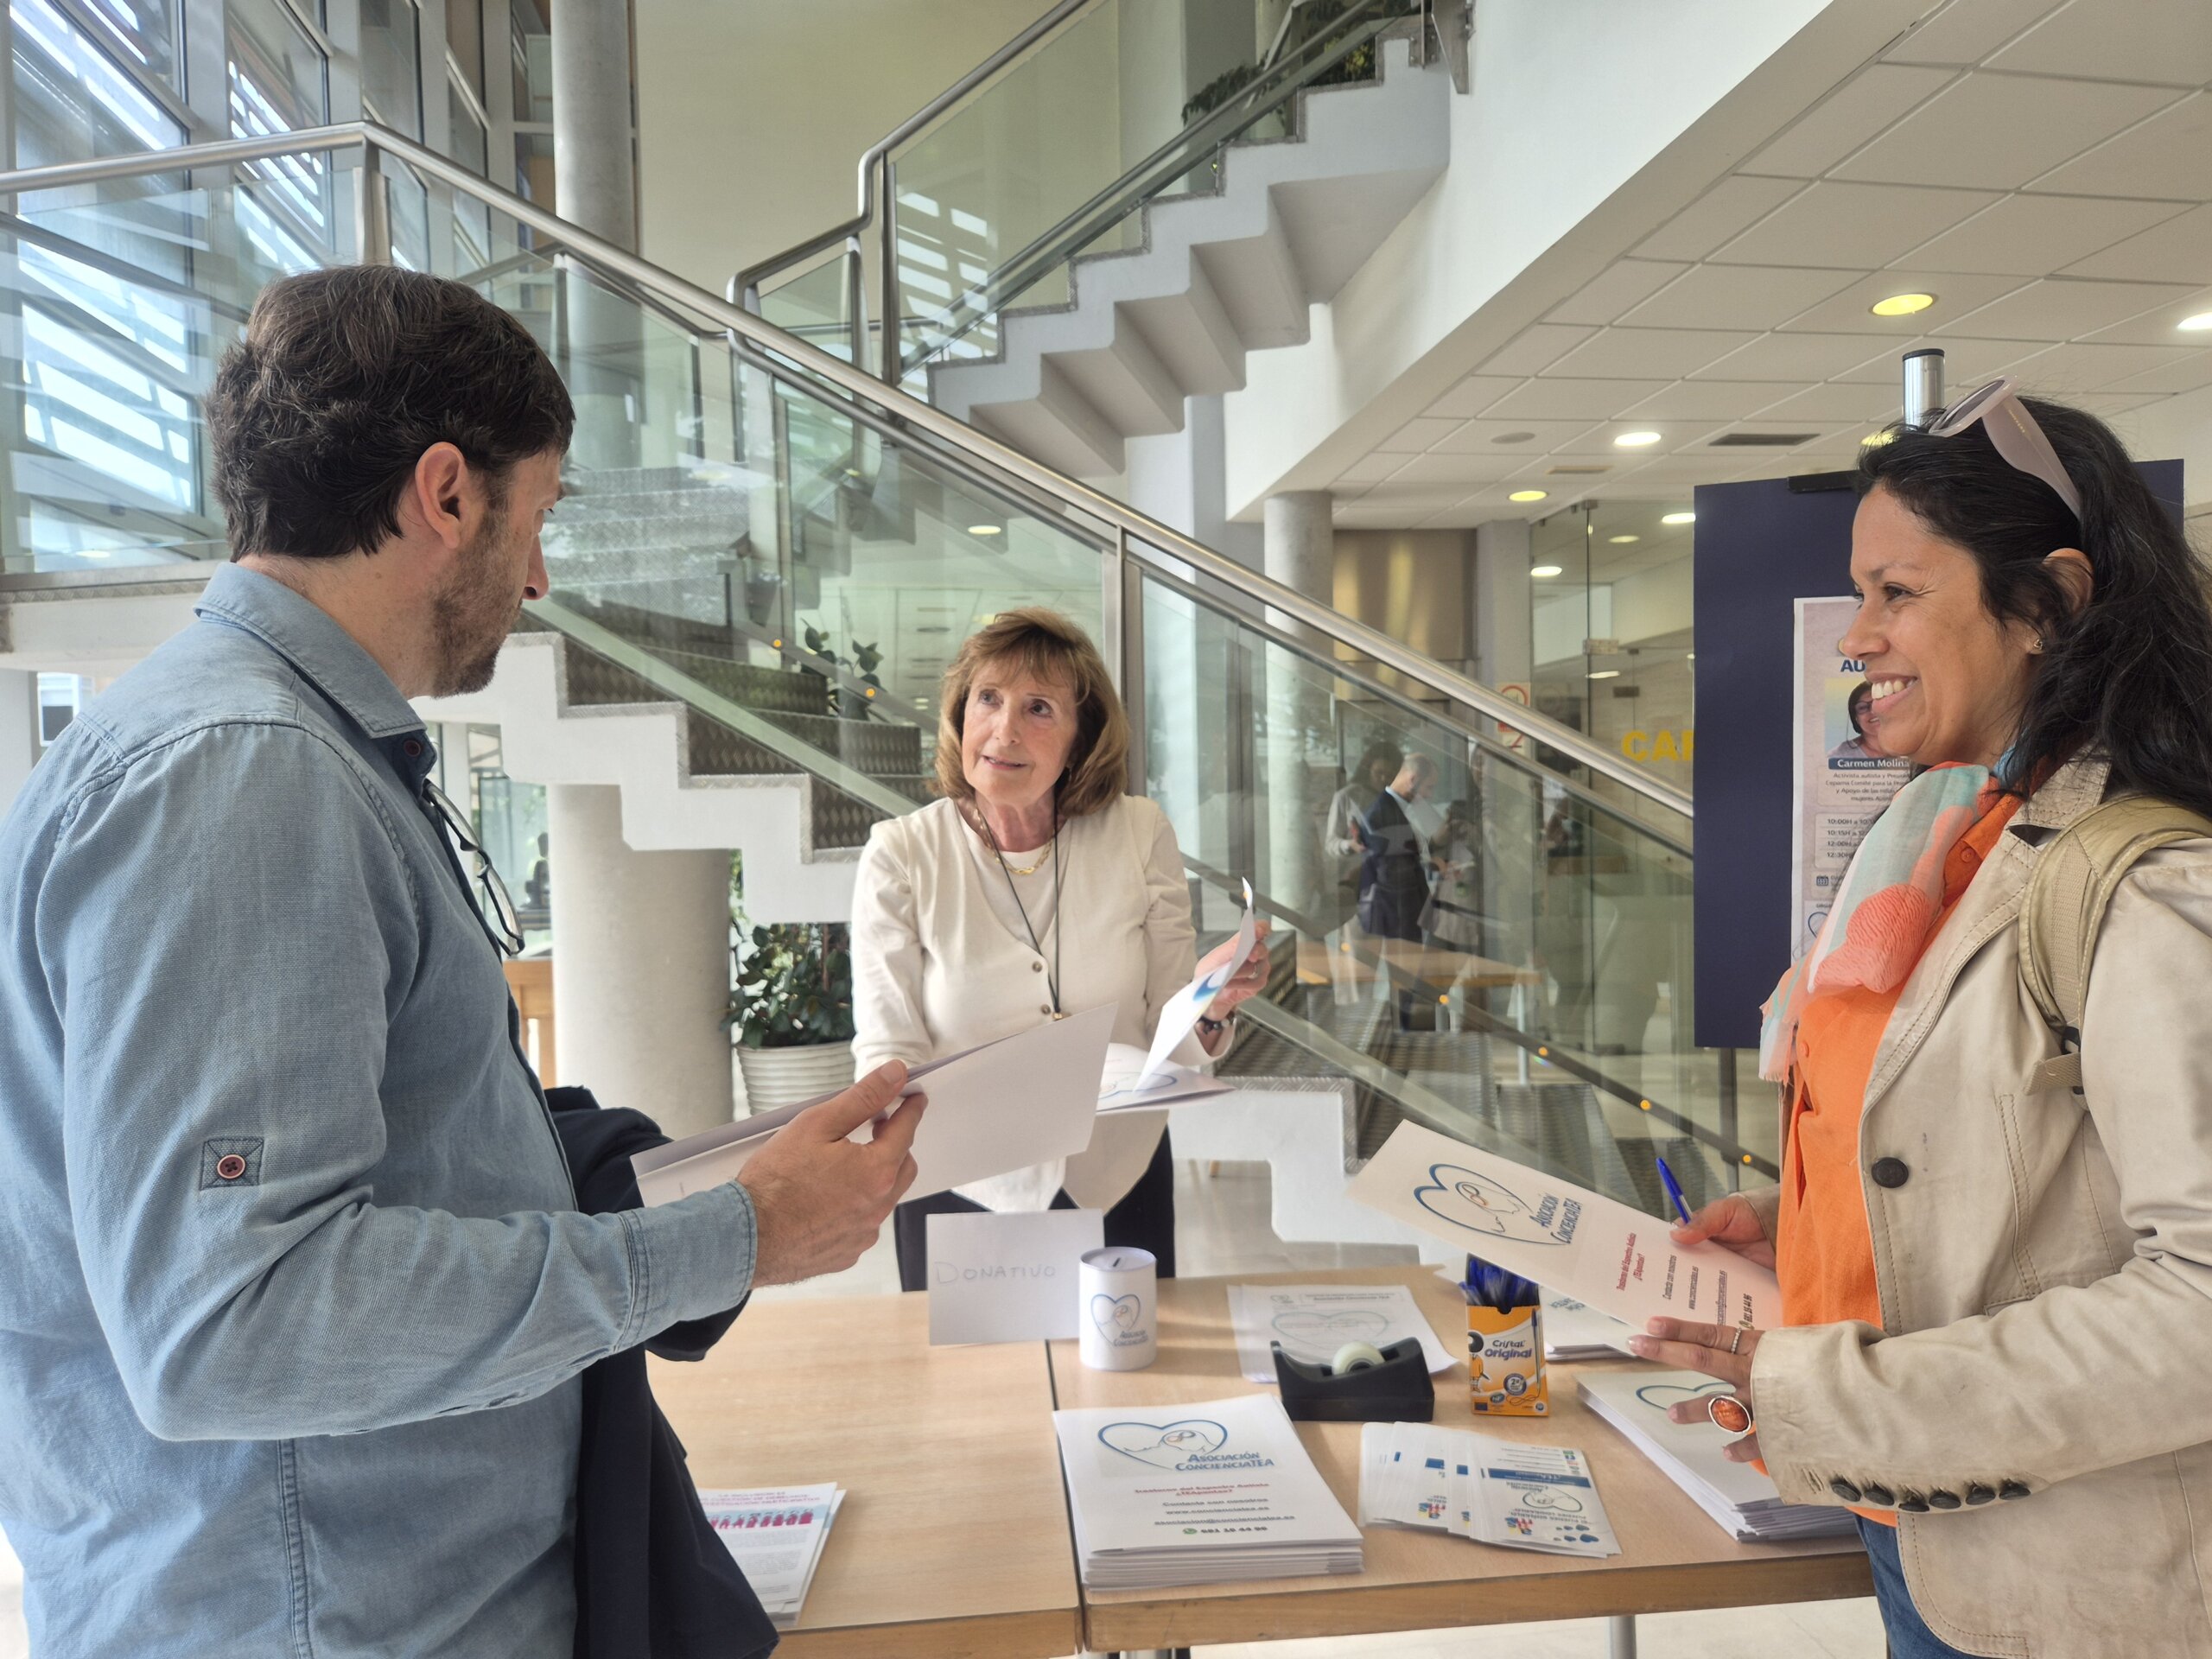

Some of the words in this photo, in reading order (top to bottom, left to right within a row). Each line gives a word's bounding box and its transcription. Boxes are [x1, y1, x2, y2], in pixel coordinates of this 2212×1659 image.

[1837, 760, 1875, 768] Carmen
[1877, 760, 1910, 768] Molina
[1484, 1348, 1532, 1360] Original
